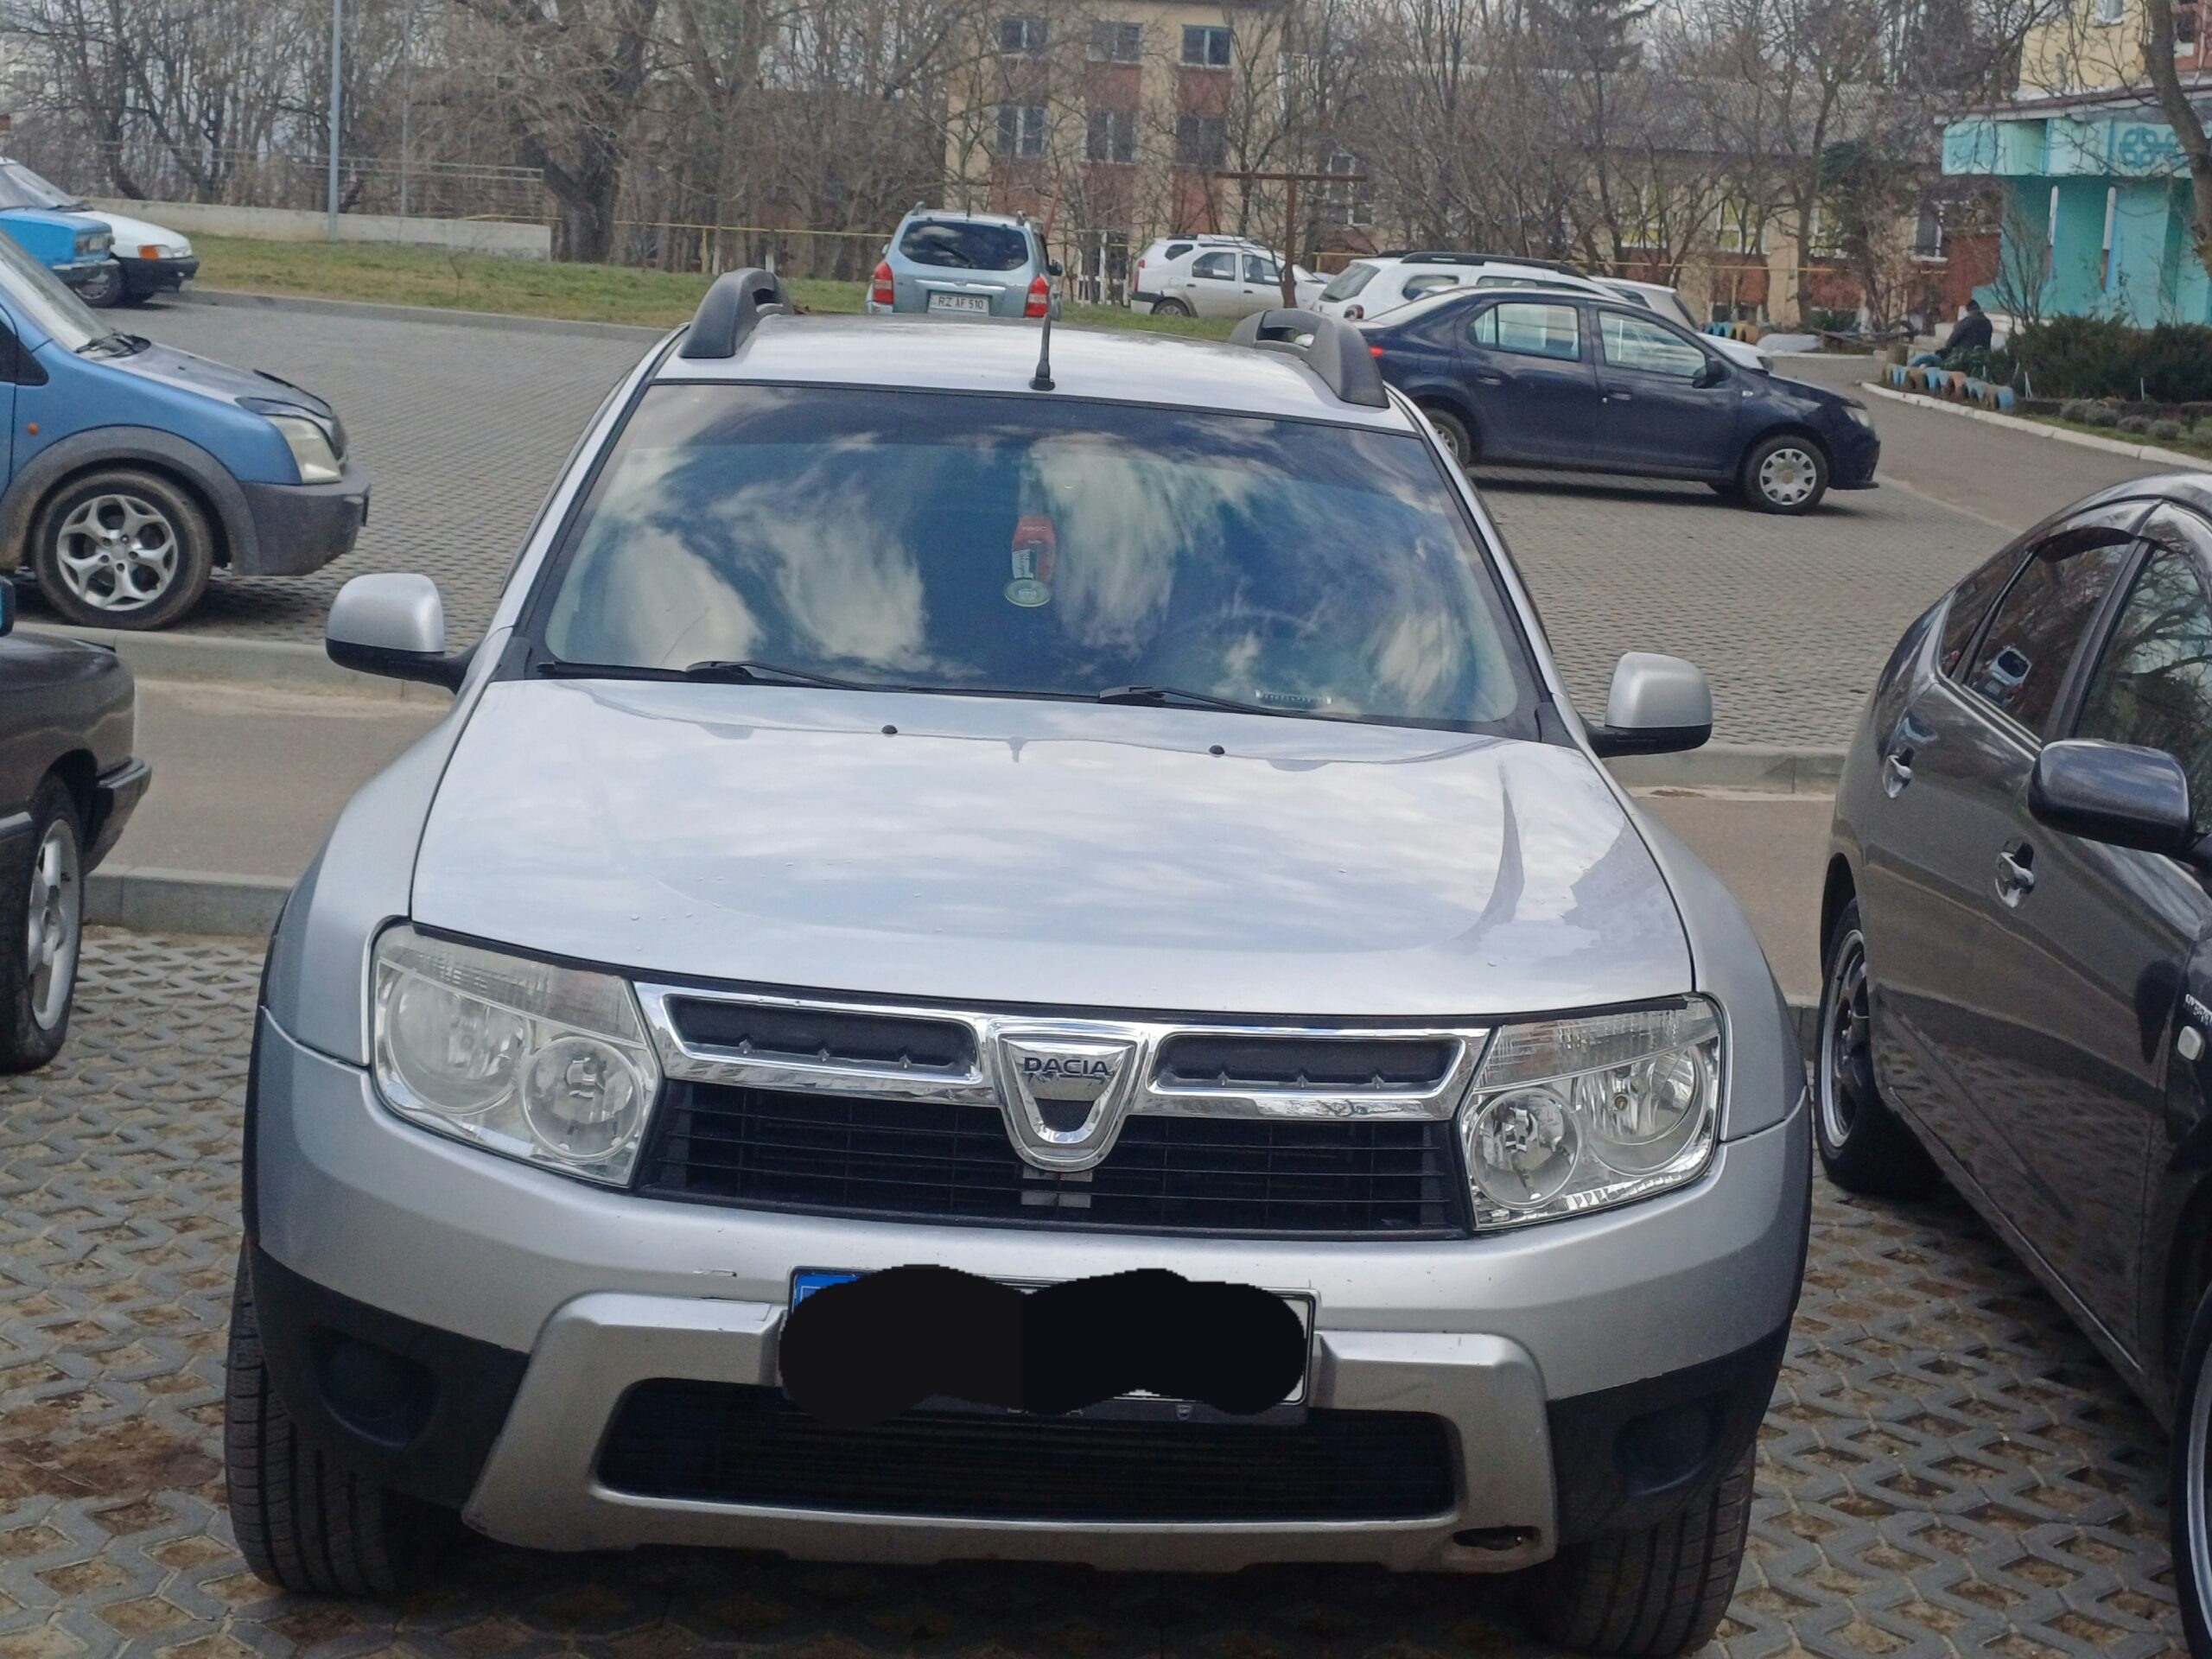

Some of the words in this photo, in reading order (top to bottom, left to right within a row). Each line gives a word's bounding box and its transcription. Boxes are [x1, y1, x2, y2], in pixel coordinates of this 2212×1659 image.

[938, 296, 952, 307] RZ
[955, 297, 966, 308] AF
[969, 299, 984, 309] 510
[1024, 1057, 1109, 1076] DACIA
